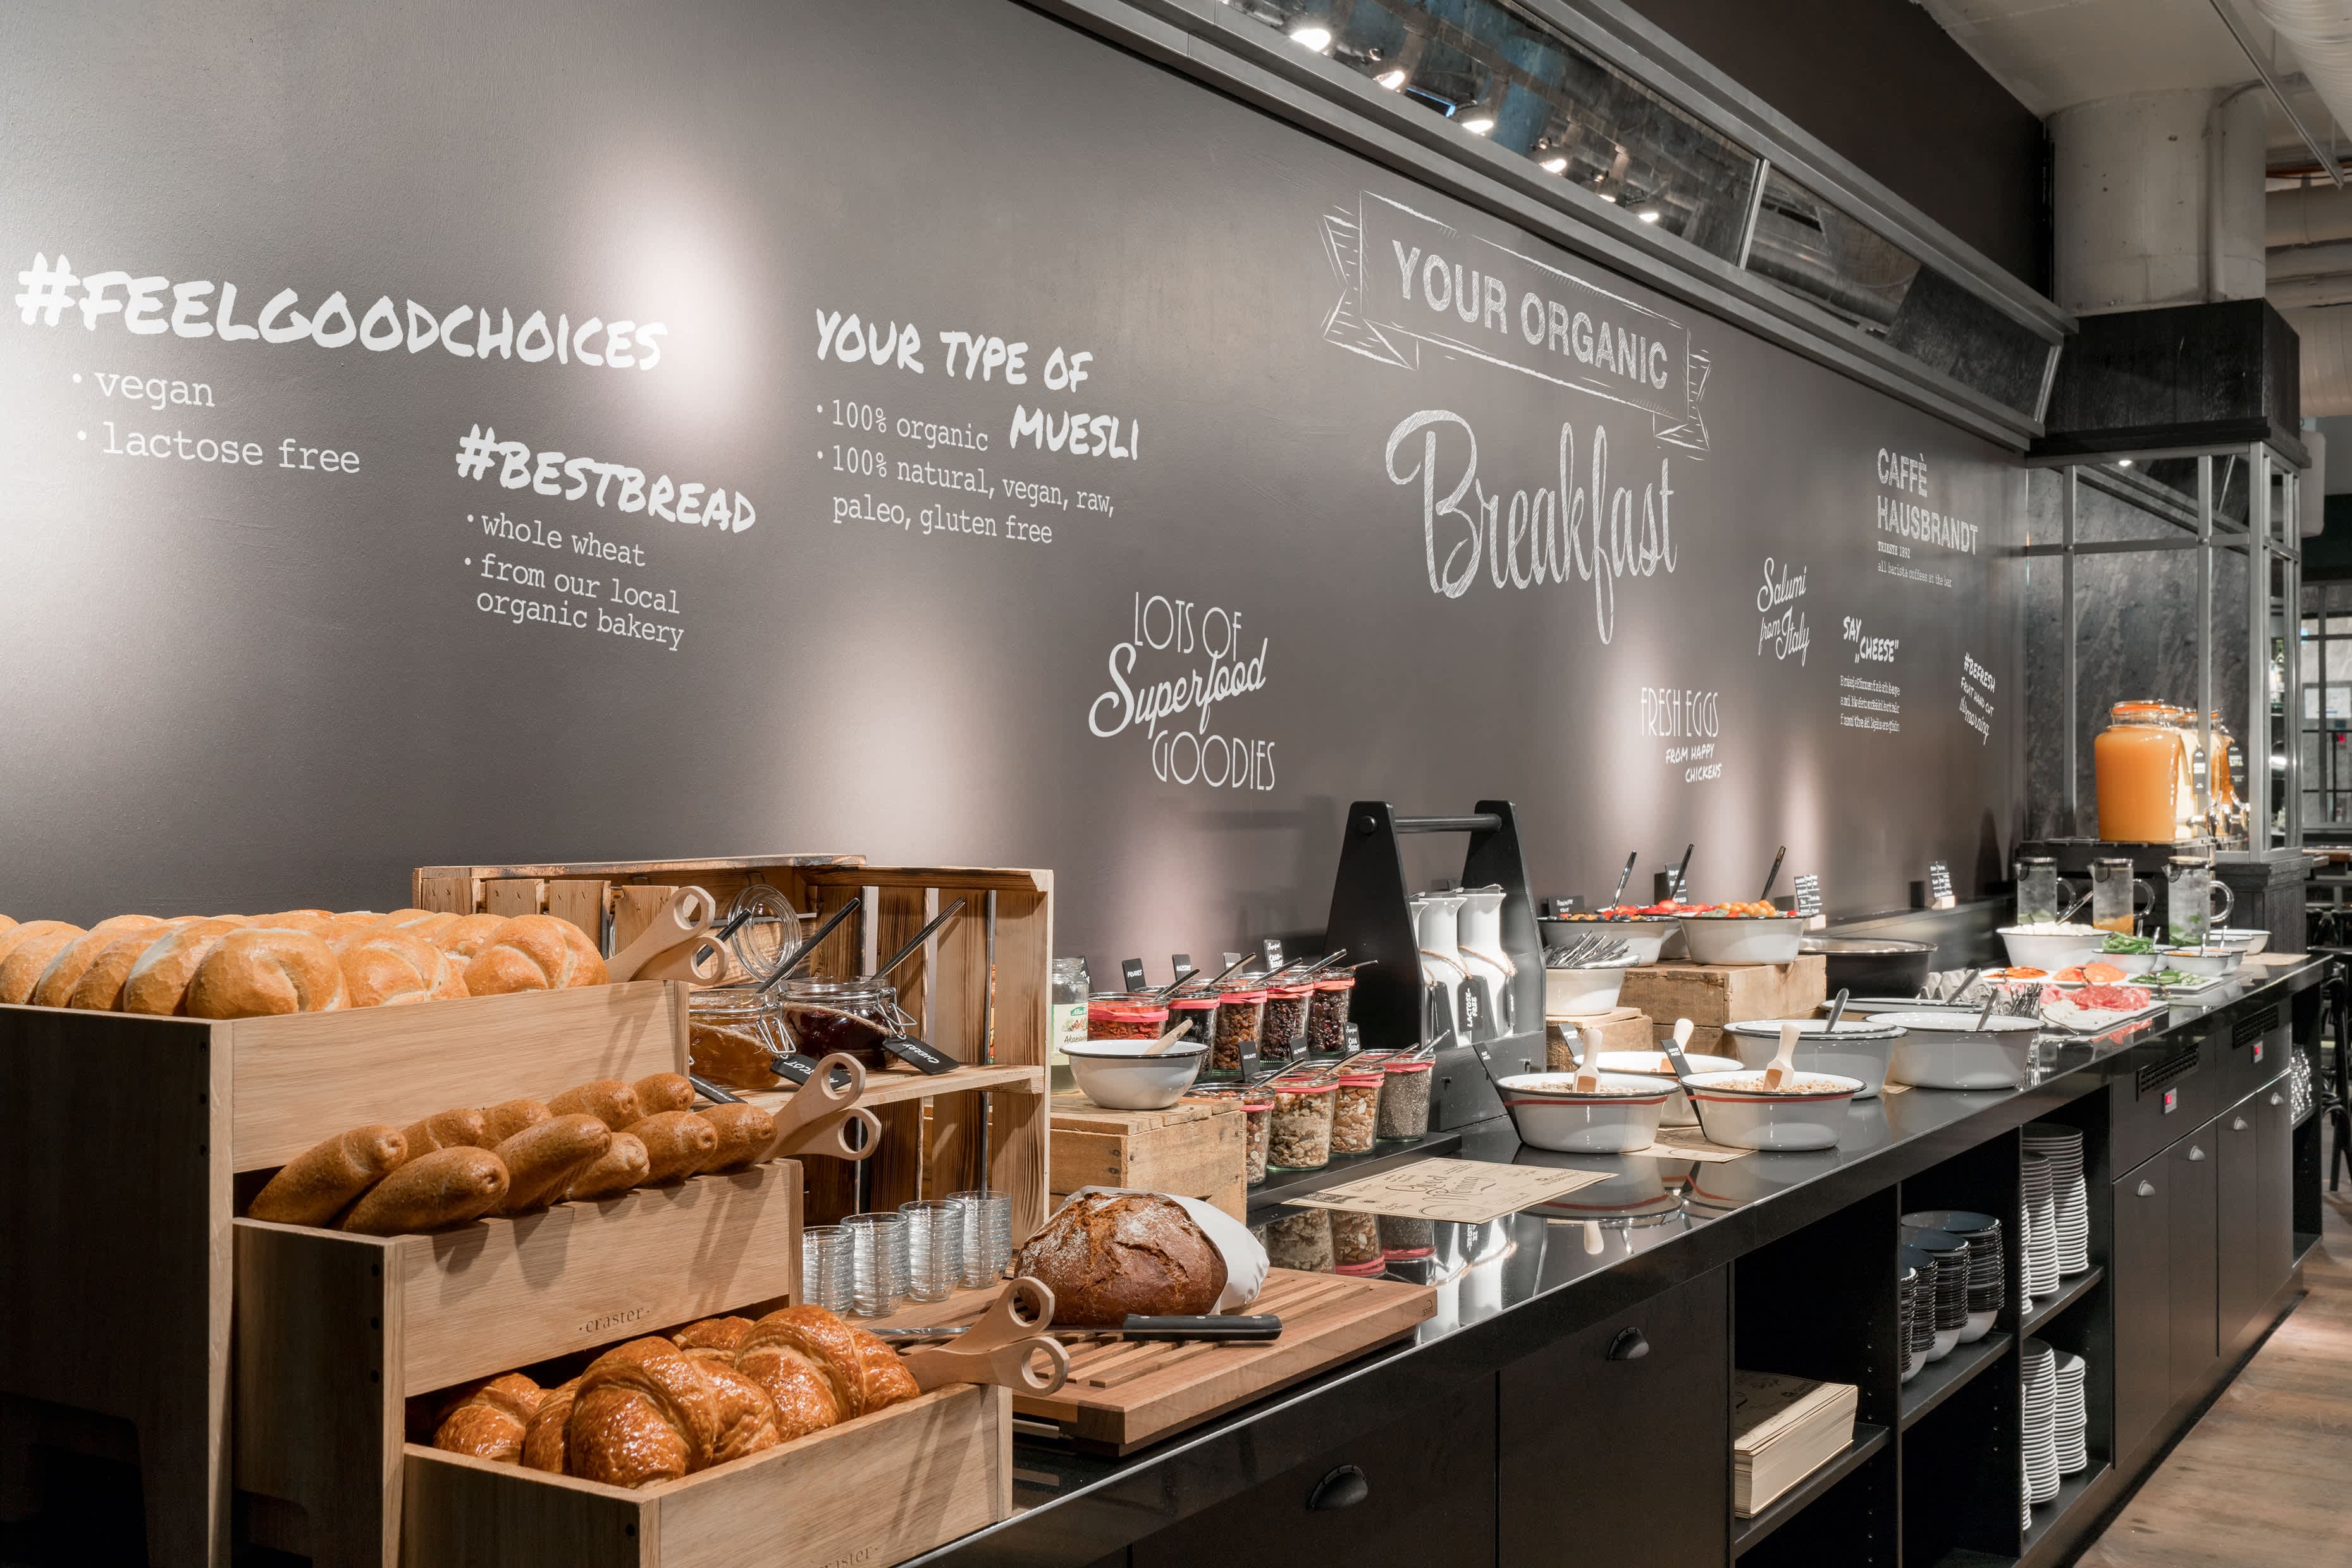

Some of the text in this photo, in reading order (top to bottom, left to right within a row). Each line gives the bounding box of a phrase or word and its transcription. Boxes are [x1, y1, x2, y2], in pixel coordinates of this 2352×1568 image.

[15, 252, 667, 370] #FEELGOODCHOICES
[1392, 240, 1668, 389] YOUR ORGANIC
[816, 309, 1093, 393] YOUR TYPE OF
[94, 372, 215, 410] vegan
[103, 422, 360, 473] lactose free
[833, 400, 988, 451] 100% organic
[1009, 404, 1138, 460] MUESLI
[456, 424, 756, 533] #BESTBREAD
[833, 444, 1114, 517] 100% natural, vegan, raw,
[1877, 448, 1928, 498] CAFFÈ
[482, 513, 645, 567] whole wheat
[833, 494, 1052, 543] paleo, gluten free
[1386, 410, 1677, 645] Breakfast
[1878, 495, 1978, 555] HAUSBRANDT
[1878, 541, 1911, 559] TRIESTE 1892
[1888, 561, 1908, 577] barista
[481, 553, 680, 614] from our local
[1757, 557, 1807, 612] Salumi
[477, 592, 684, 651] organic bakery
[1135, 592, 1241, 661] LOTS OF
[1758, 605, 1810, 668] from Italy
[1843, 616, 1862, 642] SAY
[1088, 637, 1268, 740] Superfood
[1961, 677, 1994, 717] FRUIT HAND CUT
[1964, 652, 1995, 693] #BEFRESH
[1641, 687, 1718, 737] FRESH EGGS
[1964, 709, 1990, 745] morning
[1152, 730, 1275, 791] GOODIES
[1666, 743, 1715, 764] FROM HAPPY
[1685, 763, 1722, 783] CHICKENS
[902, 1044, 940, 1063] CHERRY
[1348, 1044, 1360, 1052] SEEDS
[586, 1308, 644, 1332] craster
